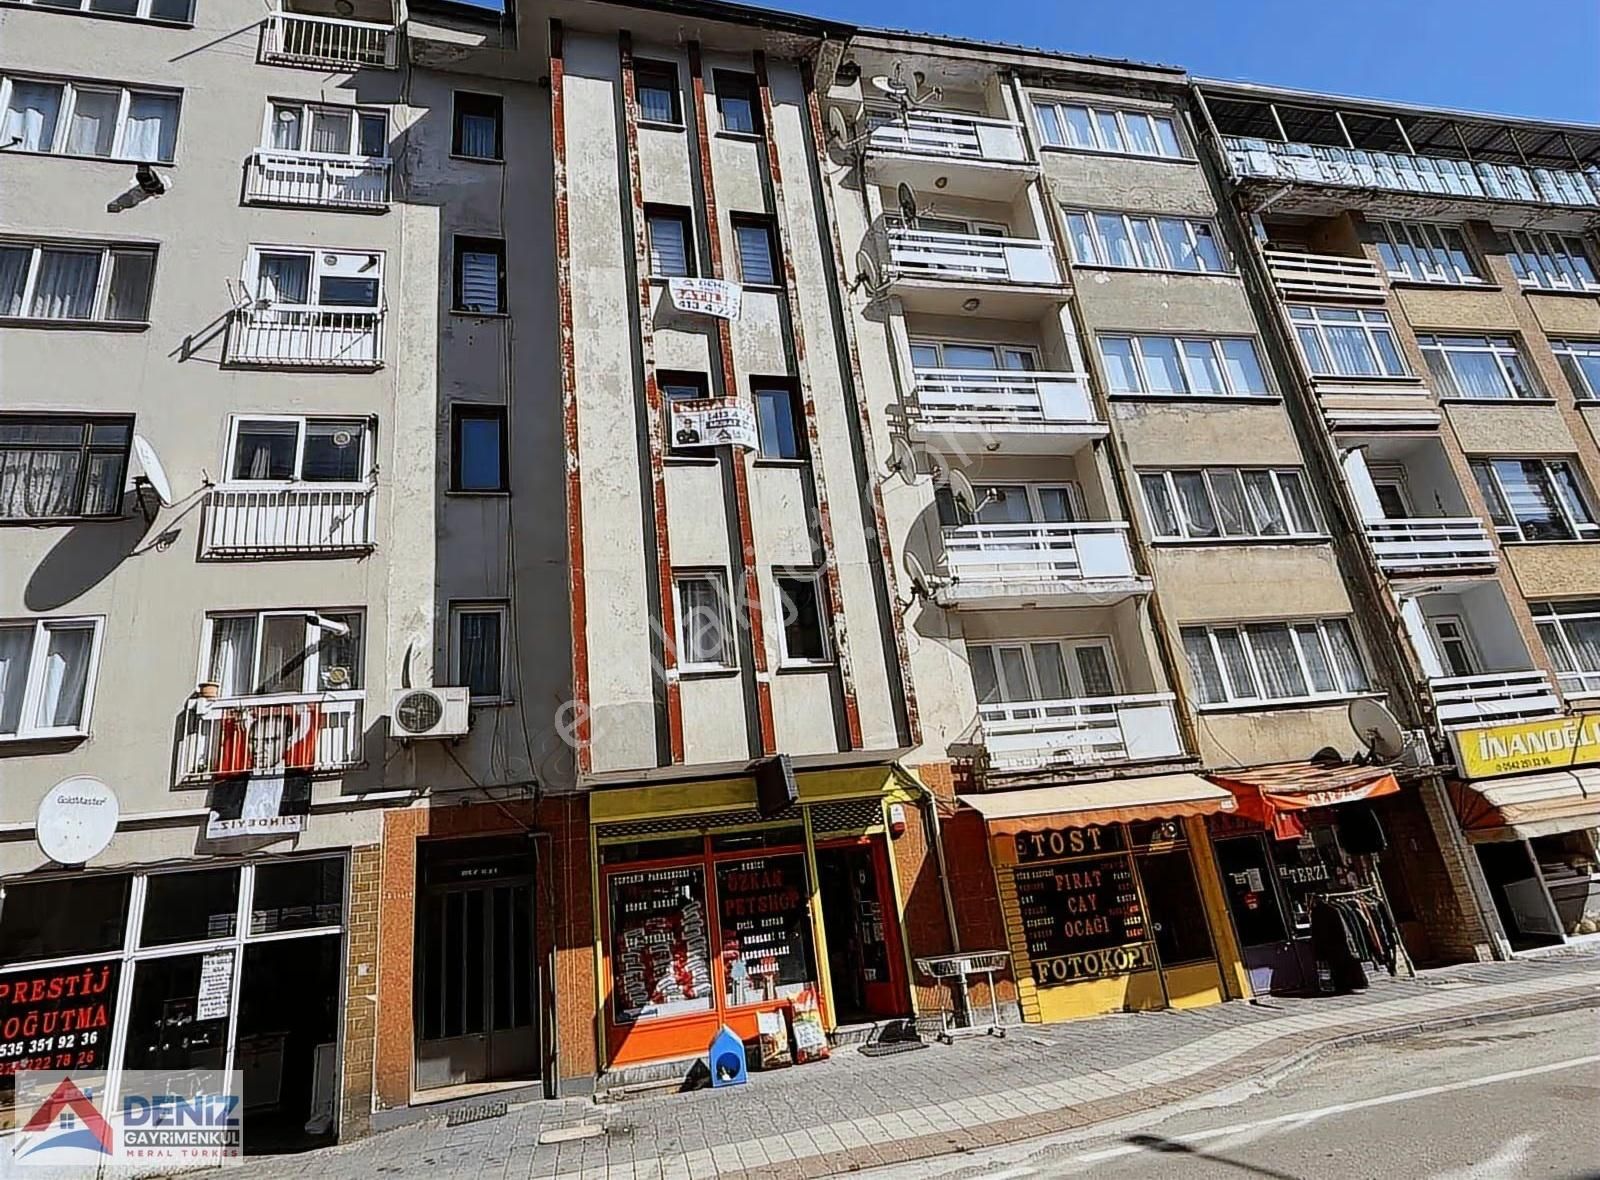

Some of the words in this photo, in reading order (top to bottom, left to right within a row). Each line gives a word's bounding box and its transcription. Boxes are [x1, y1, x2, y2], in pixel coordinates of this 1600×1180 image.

[1031, 827, 1101, 857] TOST
[1055, 870, 1101, 891] FIRAT
[1289, 860, 1329, 884] TERZİ
[1067, 893, 1096, 915] ÇAY
[0, 966, 110, 1004] PRESTİJ
[28, 1037, 54, 1053] 351
[57, 1034, 75, 1049] 92
[80, 1031, 98, 1046] 36
